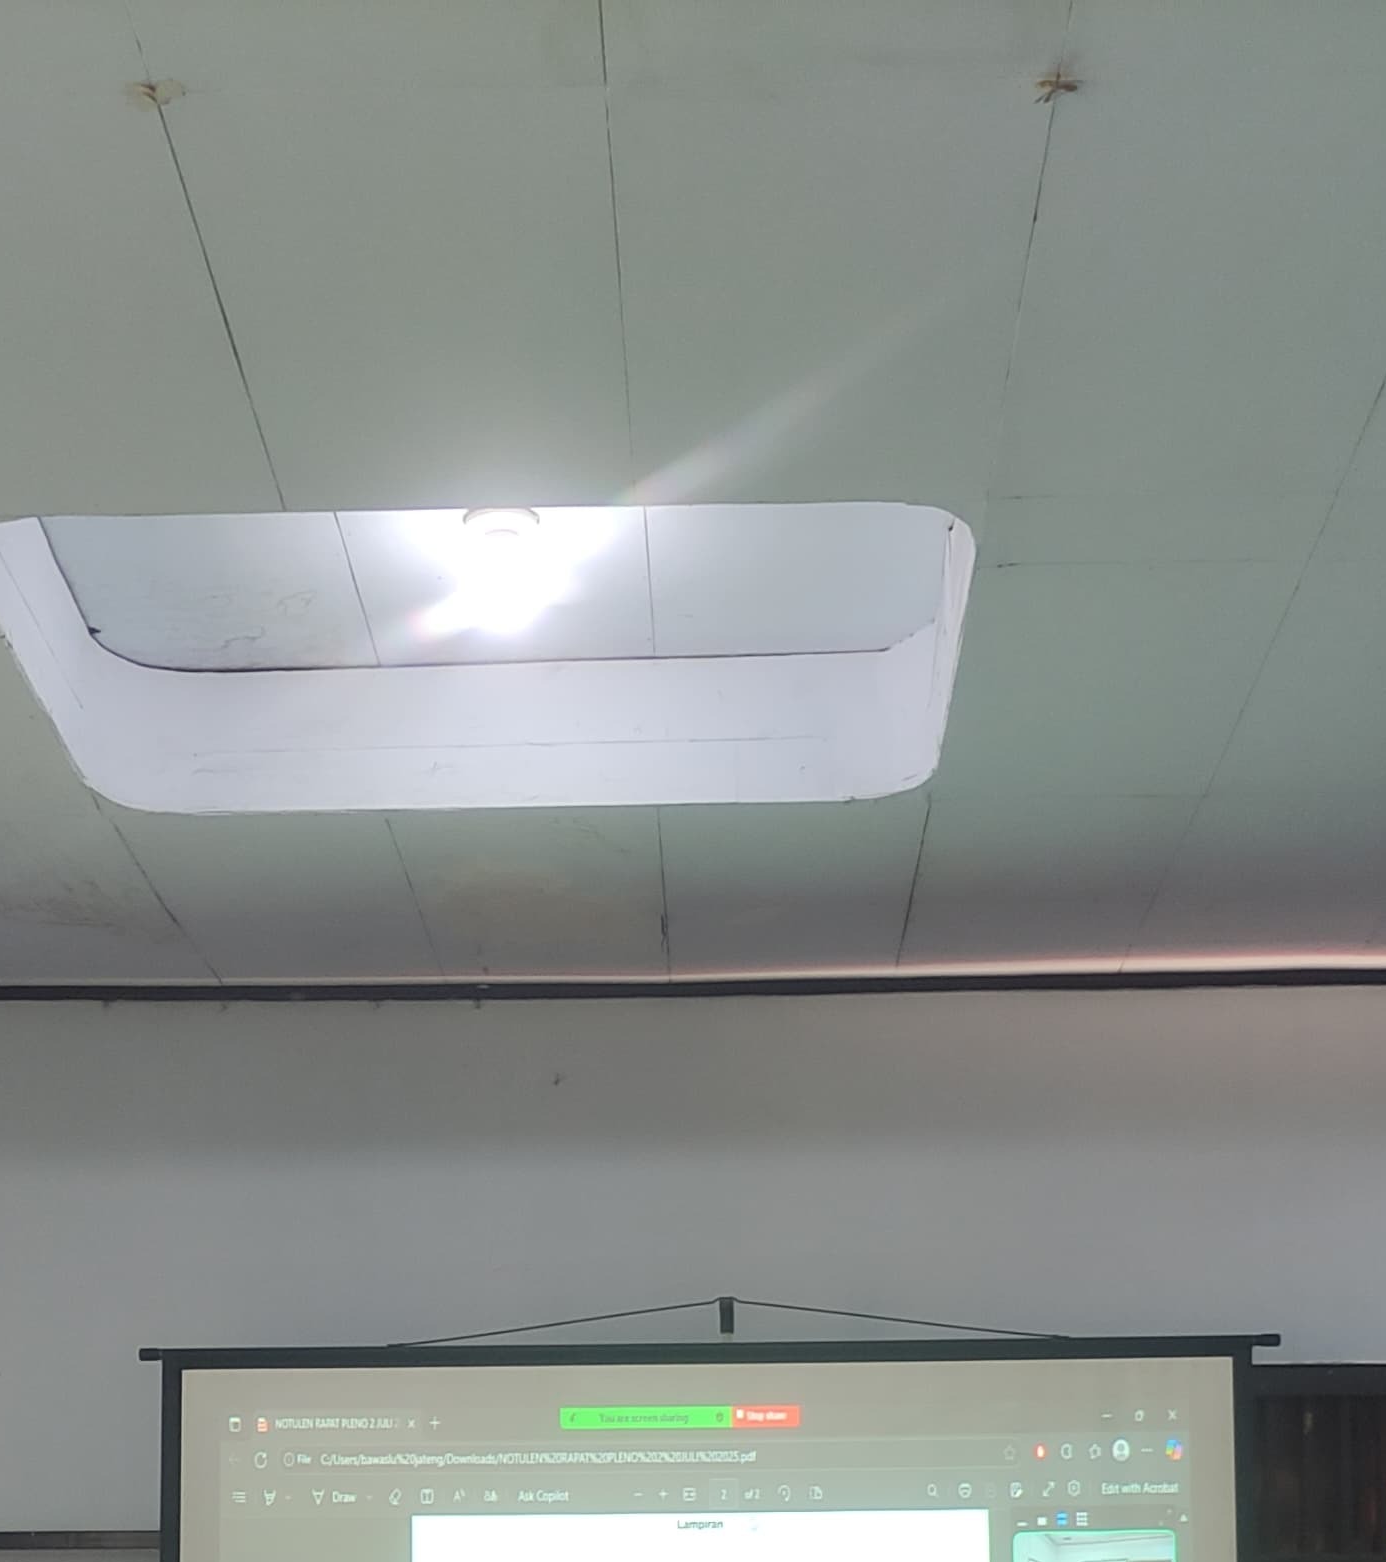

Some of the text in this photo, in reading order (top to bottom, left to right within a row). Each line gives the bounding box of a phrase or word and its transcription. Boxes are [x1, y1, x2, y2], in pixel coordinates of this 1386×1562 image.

[275, 1418, 313, 1429] NOTULEN
[332, 1491, 356, 1502] Draw
[518, 1490, 570, 1503] Ask Copilot
[677, 1519, 724, 1530] Lampiran
